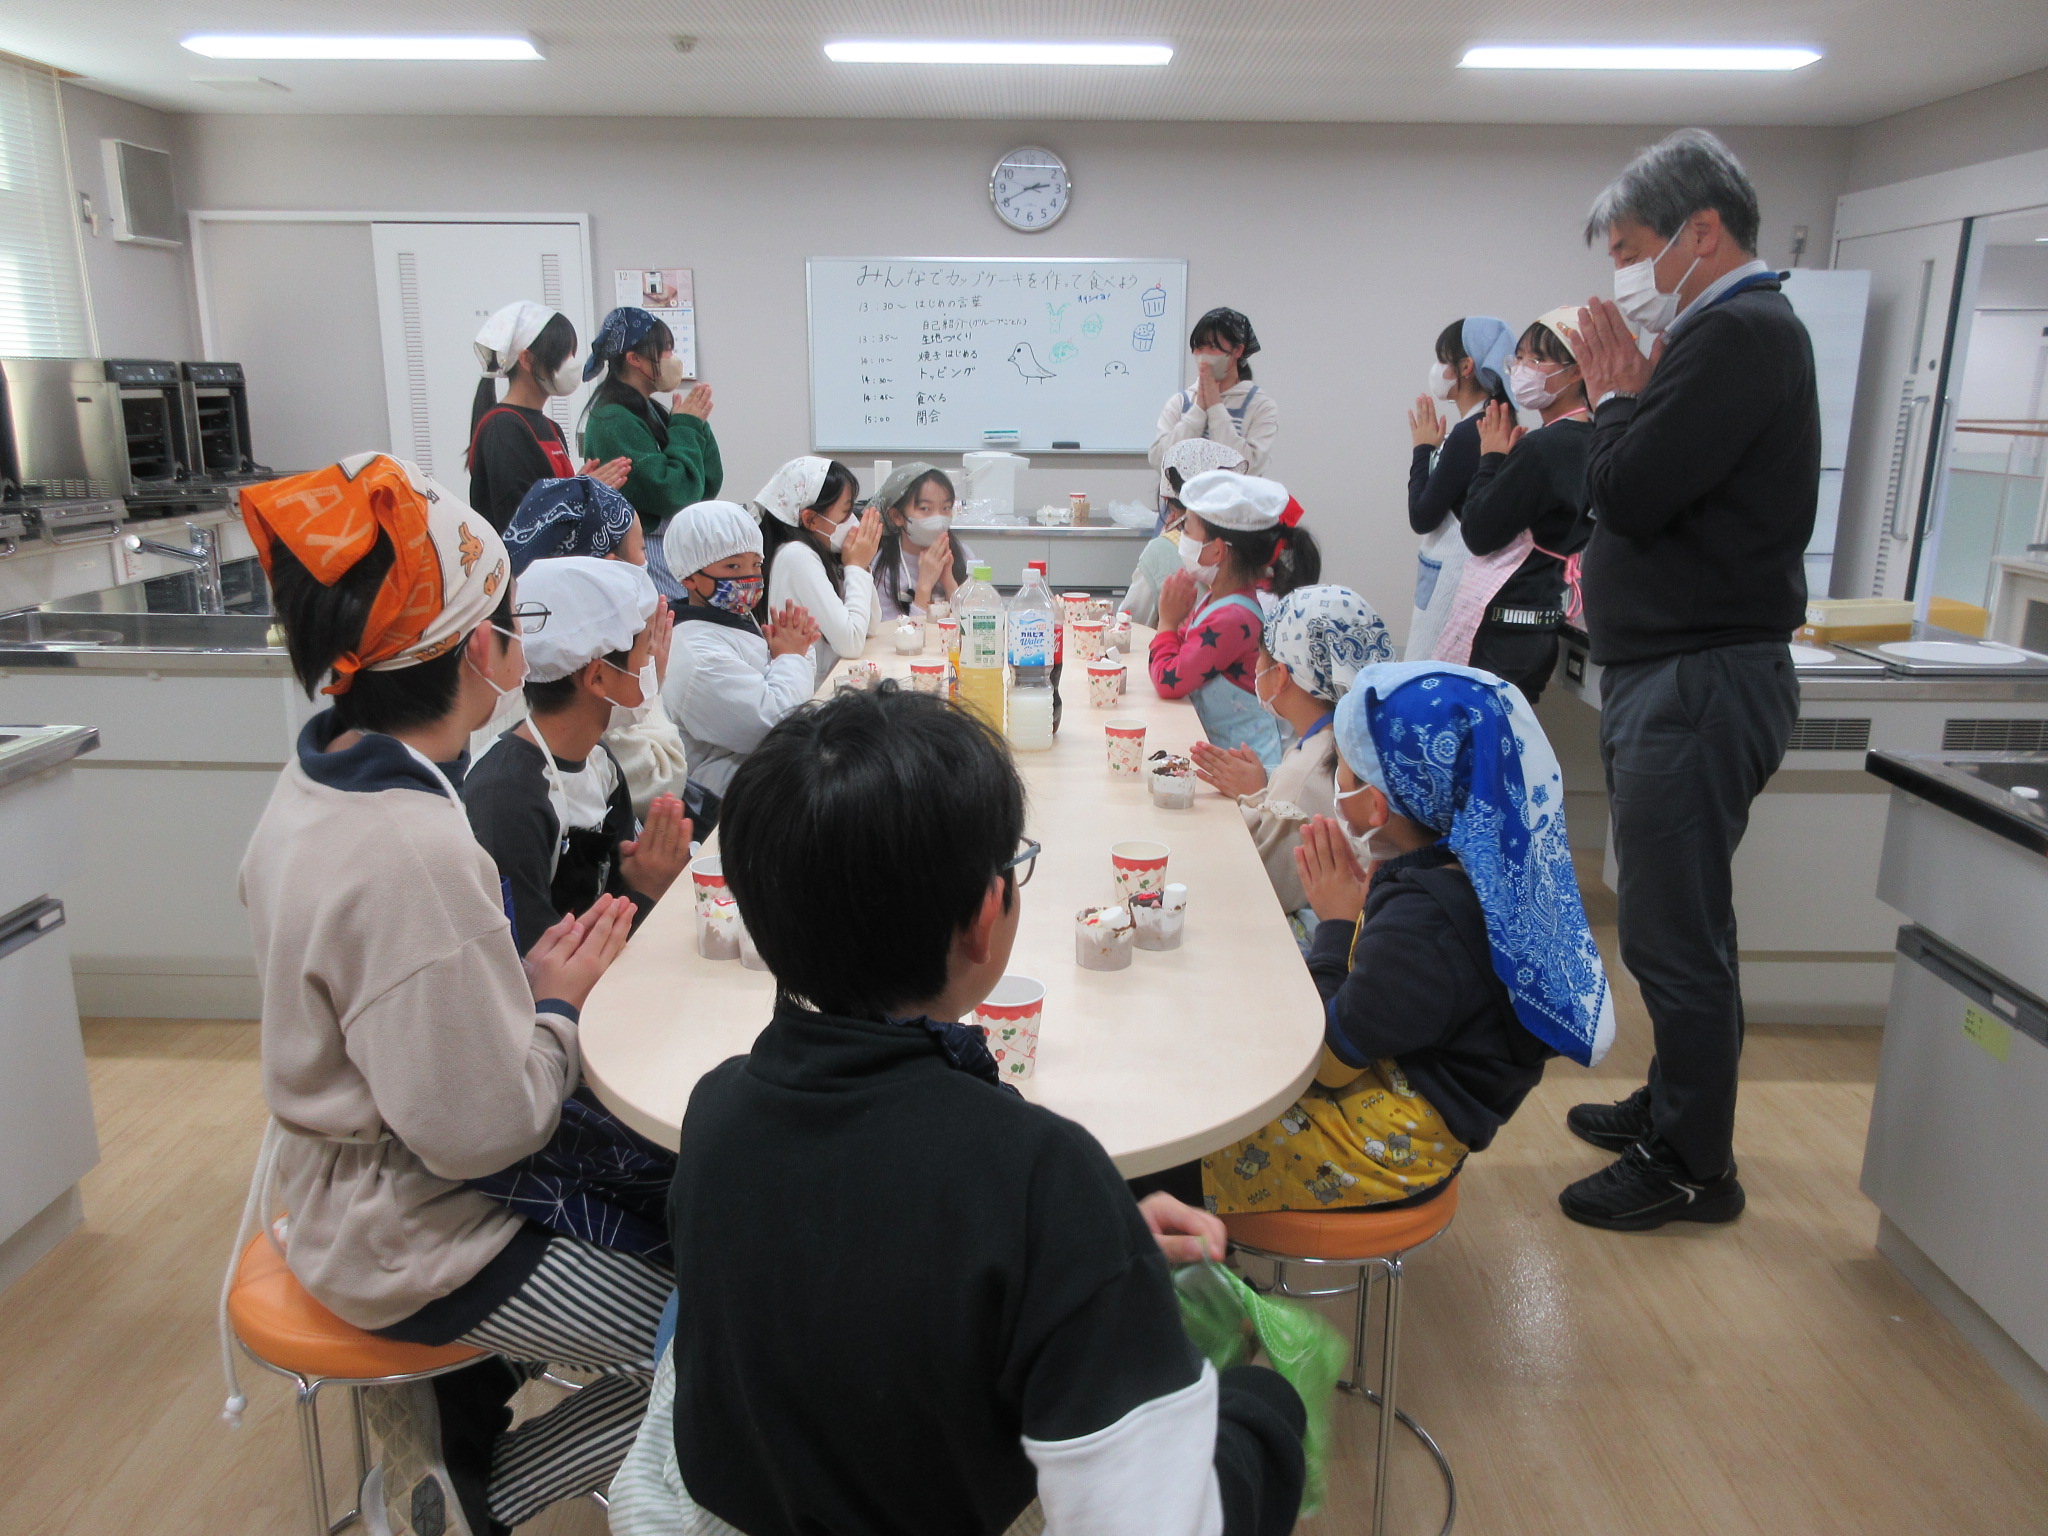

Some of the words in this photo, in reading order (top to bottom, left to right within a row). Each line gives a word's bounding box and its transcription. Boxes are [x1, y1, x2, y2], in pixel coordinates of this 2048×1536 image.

[1003, 169, 1014, 179] 10
[1050, 169, 1058, 179] 2
[999, 183, 1006, 193] 9
[1055, 184, 1061, 194] 3
[1003, 197, 1010, 208] 8
[1050, 198, 1057, 208] 4
[1014, 208, 1020, 218] 7
[1026, 211, 1034, 222] 6
[1040, 208, 1047, 219] 5
[915, 296, 983, 310] はじめの言葉
[921, 332, 973, 346] 生地づくり
[920, 366, 977, 381] トッピング
[916, 391, 948, 406] 食べる
[916, 409, 942, 427] 閉会
[1492, 607, 1536, 624] PUMA
[1020, 631, 1045, 639] カルピス
[1019, 637, 1045, 647] Water
